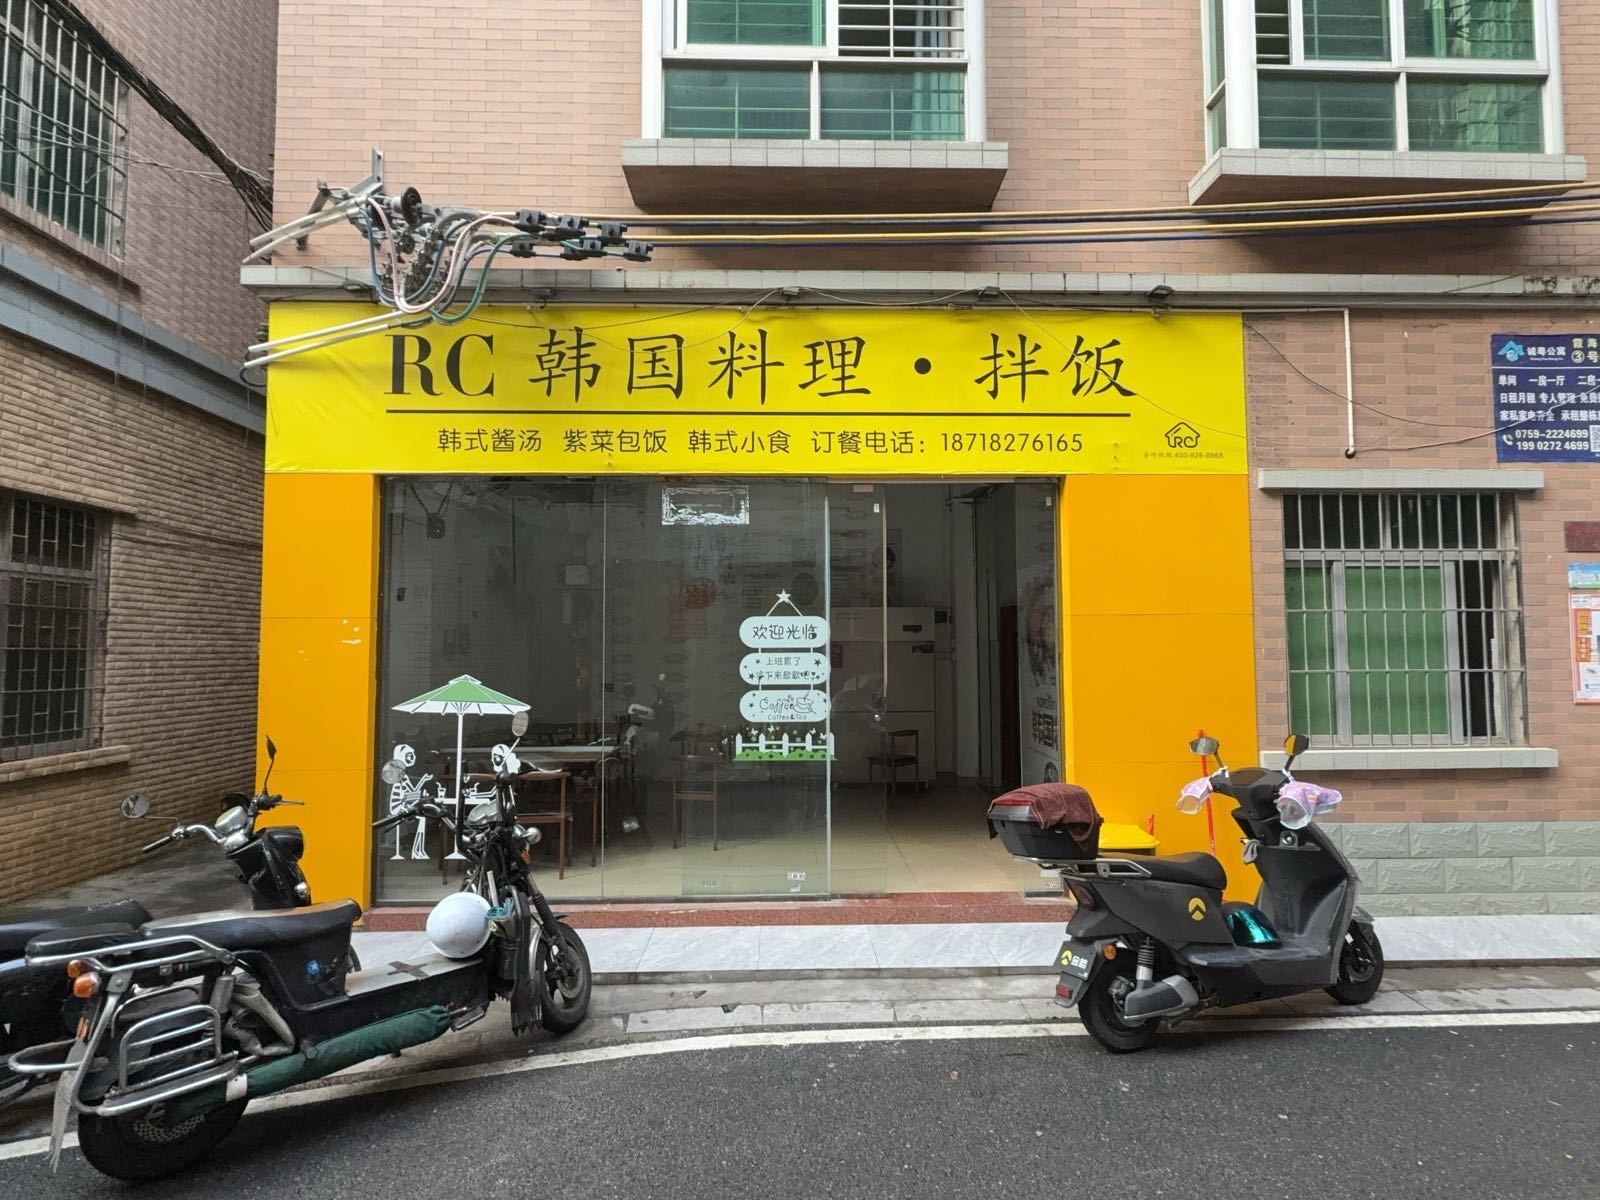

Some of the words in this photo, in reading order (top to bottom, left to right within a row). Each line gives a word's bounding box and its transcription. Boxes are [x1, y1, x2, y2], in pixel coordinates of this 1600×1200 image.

[384, 334, 495, 397] RC
[1498, 375, 1517, 386] 单间
[1528, 375, 1565, 386] 一房一厅
[1500, 392, 1536, 404] 日租月租
[1580, 392, 1600, 404] 免费
[1561, 410, 1600, 421] 承租整栋
[1515, 429, 1588, 439] 0759-2224699
[438, 428, 542, 453] 韩式酱汤
[564, 428, 668, 455] 紫菜包饭
[688, 429, 791, 454] 韩式小食
[941, 433, 1083, 452] 18718276165
[1517, 441, 1534, 450] 199
[1537, 441, 1562, 450] 0272
[1564, 441, 1589, 450] 4699
[752, 624, 818, 640] 欢迎光临
